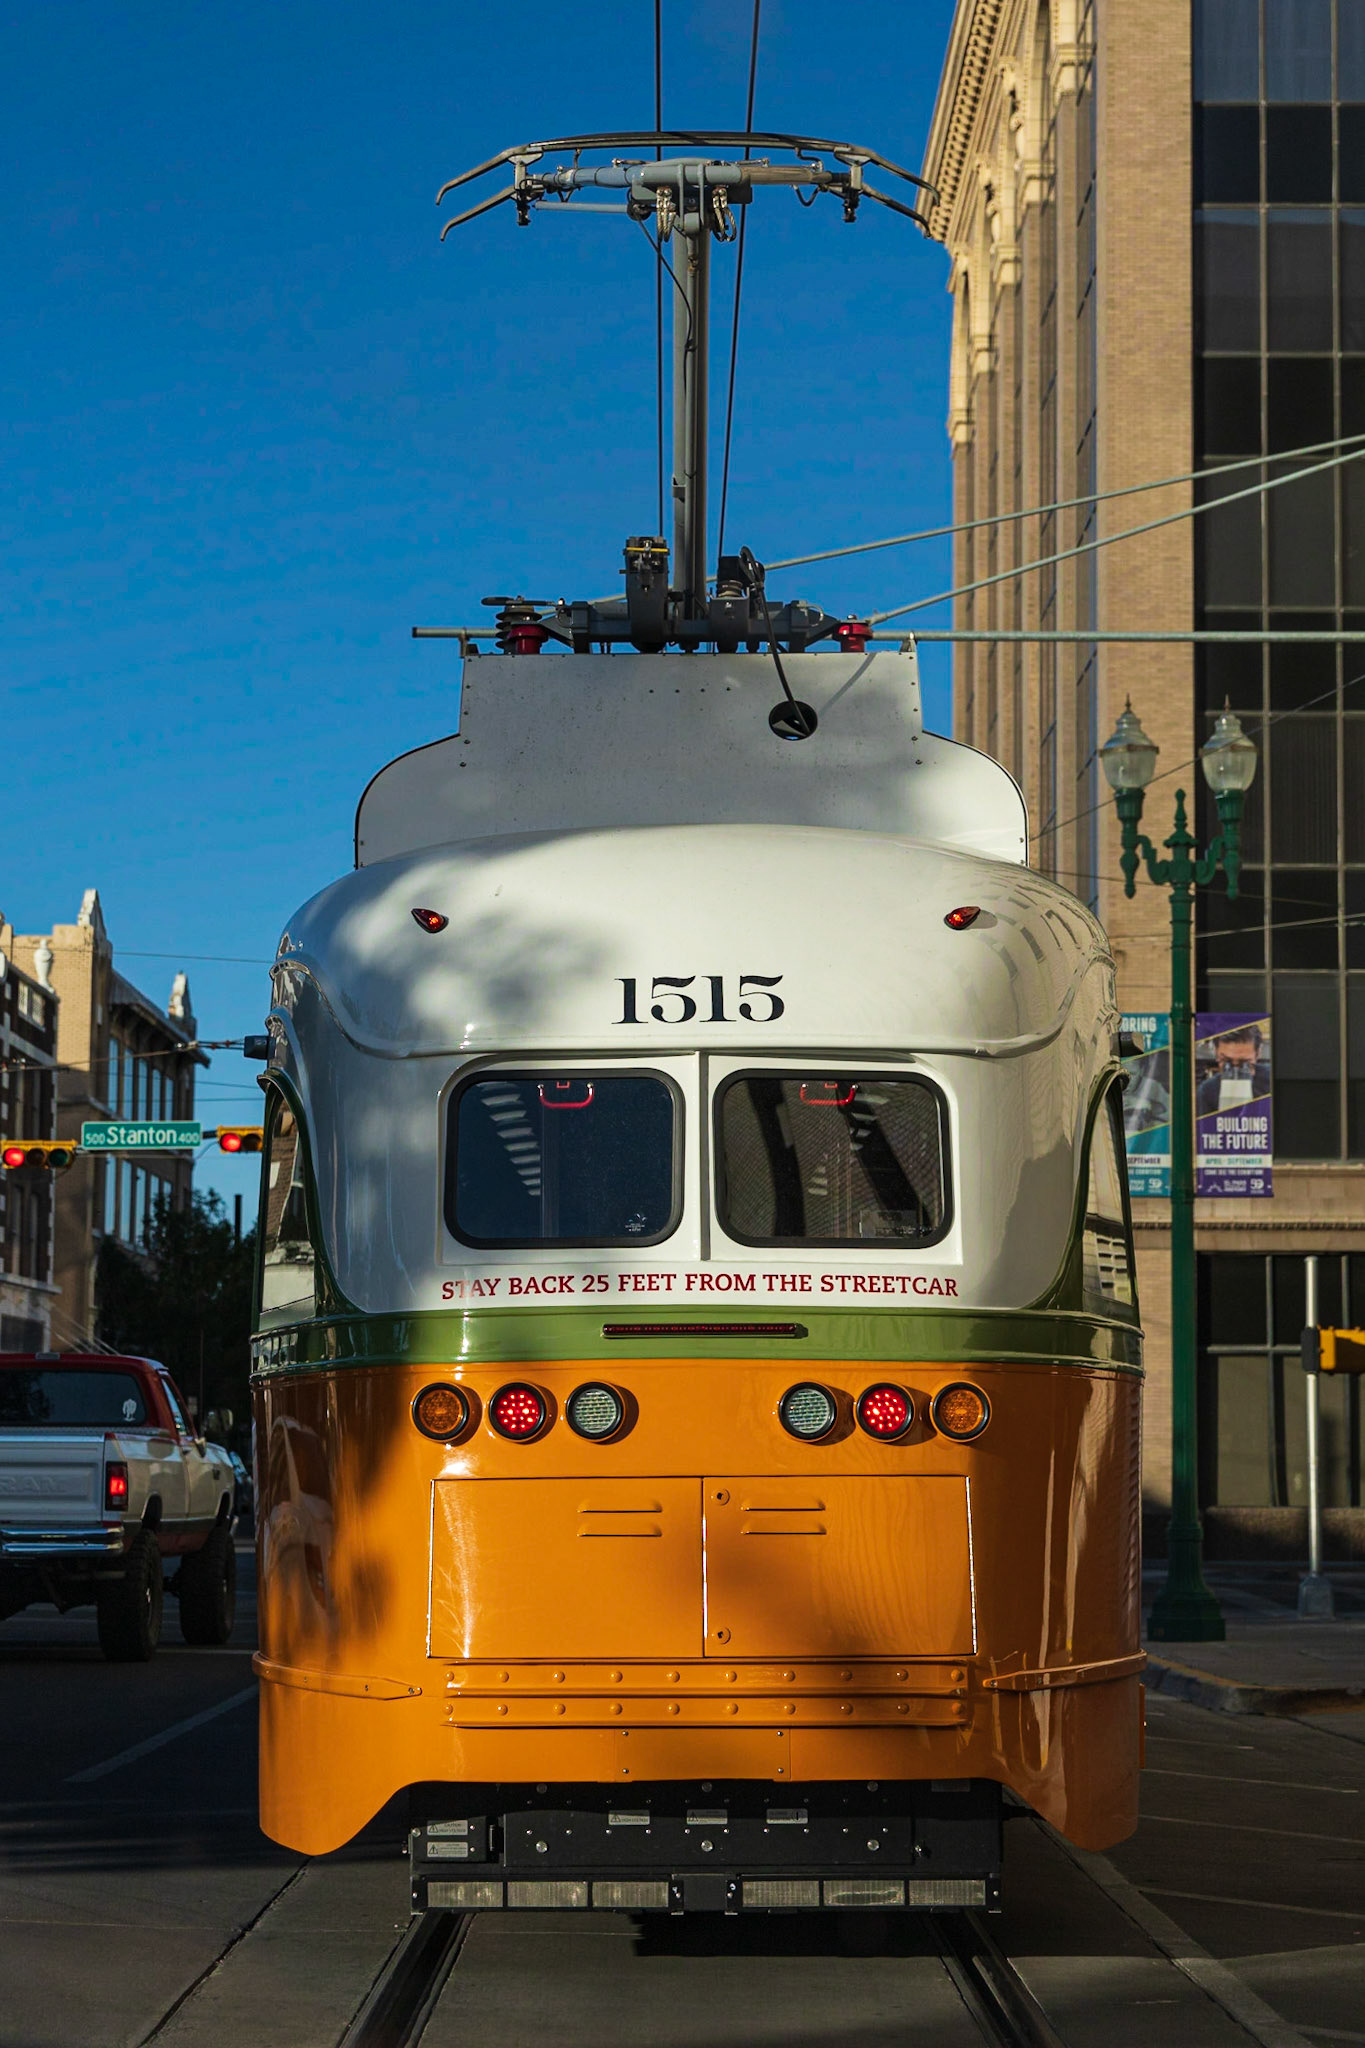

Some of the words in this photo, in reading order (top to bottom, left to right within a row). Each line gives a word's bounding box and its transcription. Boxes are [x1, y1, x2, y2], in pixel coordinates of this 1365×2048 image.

[611, 975, 785, 1024] 1515
[1216, 1117, 1268, 1132] BUILDING
[85, 1132, 105, 1145] 500
[107, 1126, 177, 1145] Stanton
[178, 1132, 199, 1144] 400
[1202, 1134, 1223, 1149] THE
[1226, 1134, 1268, 1149] FUTURE
[442, 1278, 501, 1300] STAY
[508, 1275, 575, 1297] BACK
[581, 1274, 609, 1294] 25
[617, 1273, 677, 1292] FEET
[685, 1273, 756, 1292] FROM
[762, 1273, 813, 1293] THE
[820, 1274, 959, 1297] STREETCAR
